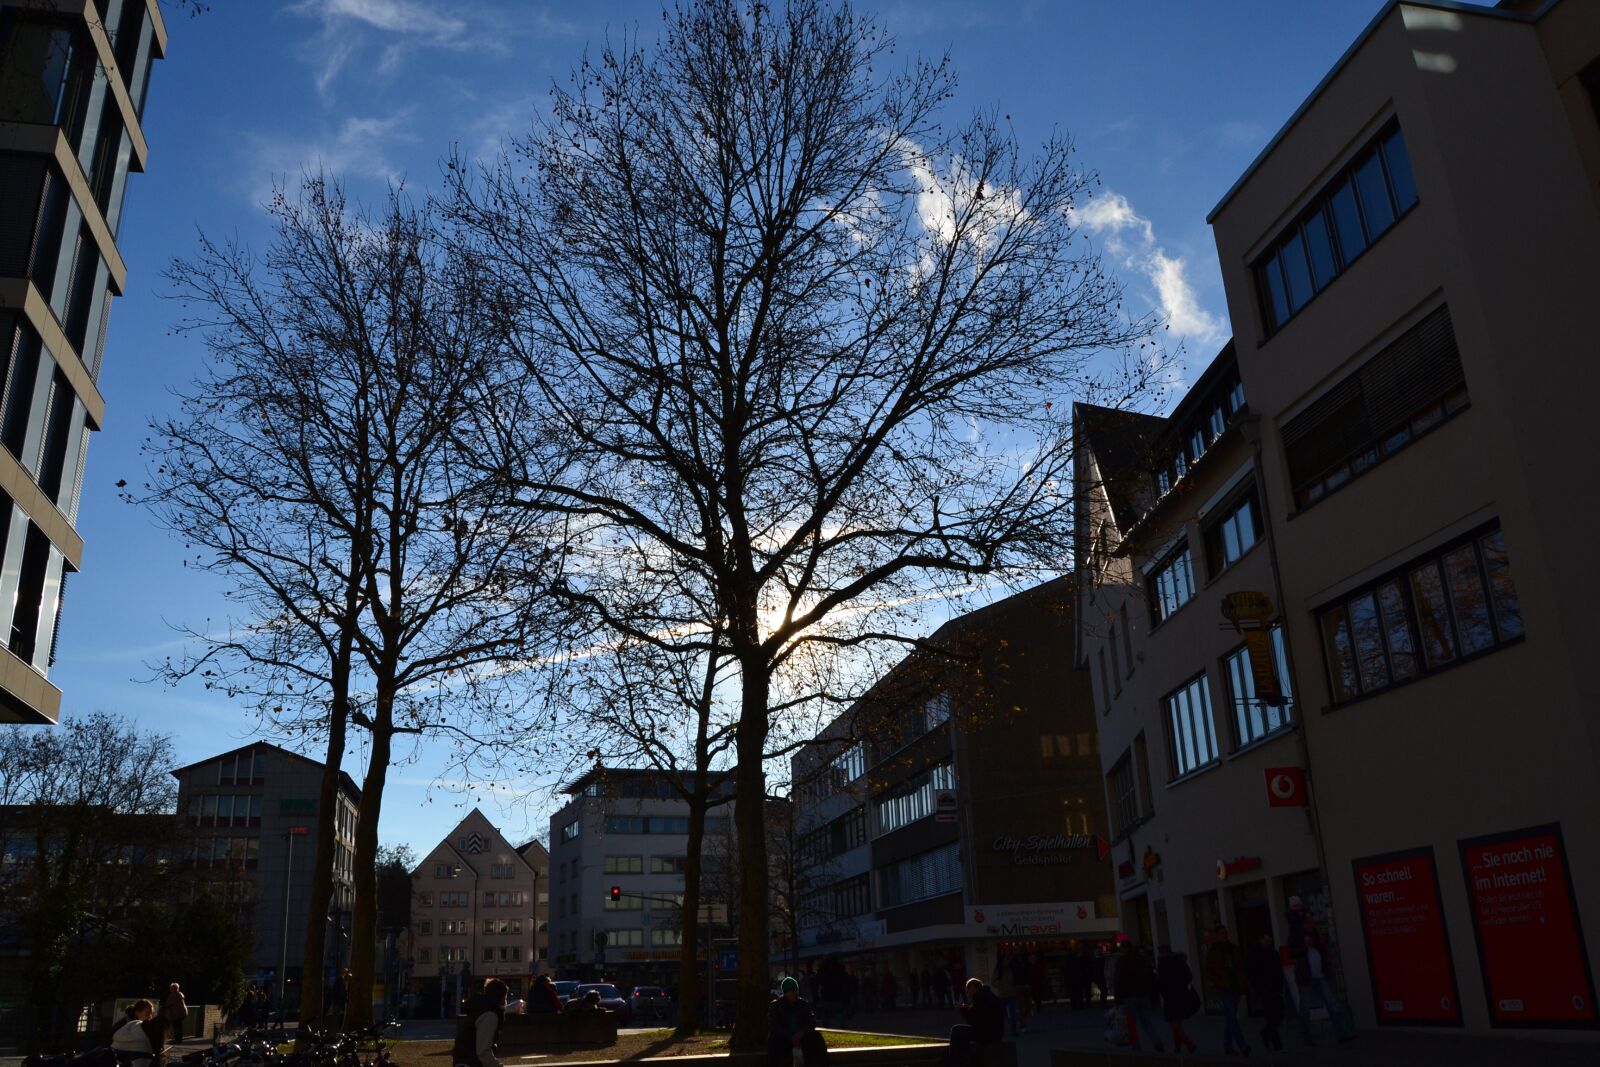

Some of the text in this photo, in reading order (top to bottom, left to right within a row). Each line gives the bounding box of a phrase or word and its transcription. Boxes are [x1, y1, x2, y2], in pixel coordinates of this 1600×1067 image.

[993, 833, 1090, 854] City-Spielhallen
[1482, 852, 1501, 868] Sie
[1502, 846, 1532, 864] noch
[1534, 843, 1554, 860] nie
[1362, 865, 1413, 886] So schnell
[1474, 866, 1547, 890] im Internet!
[1001, 921, 1061, 936] Miraval
